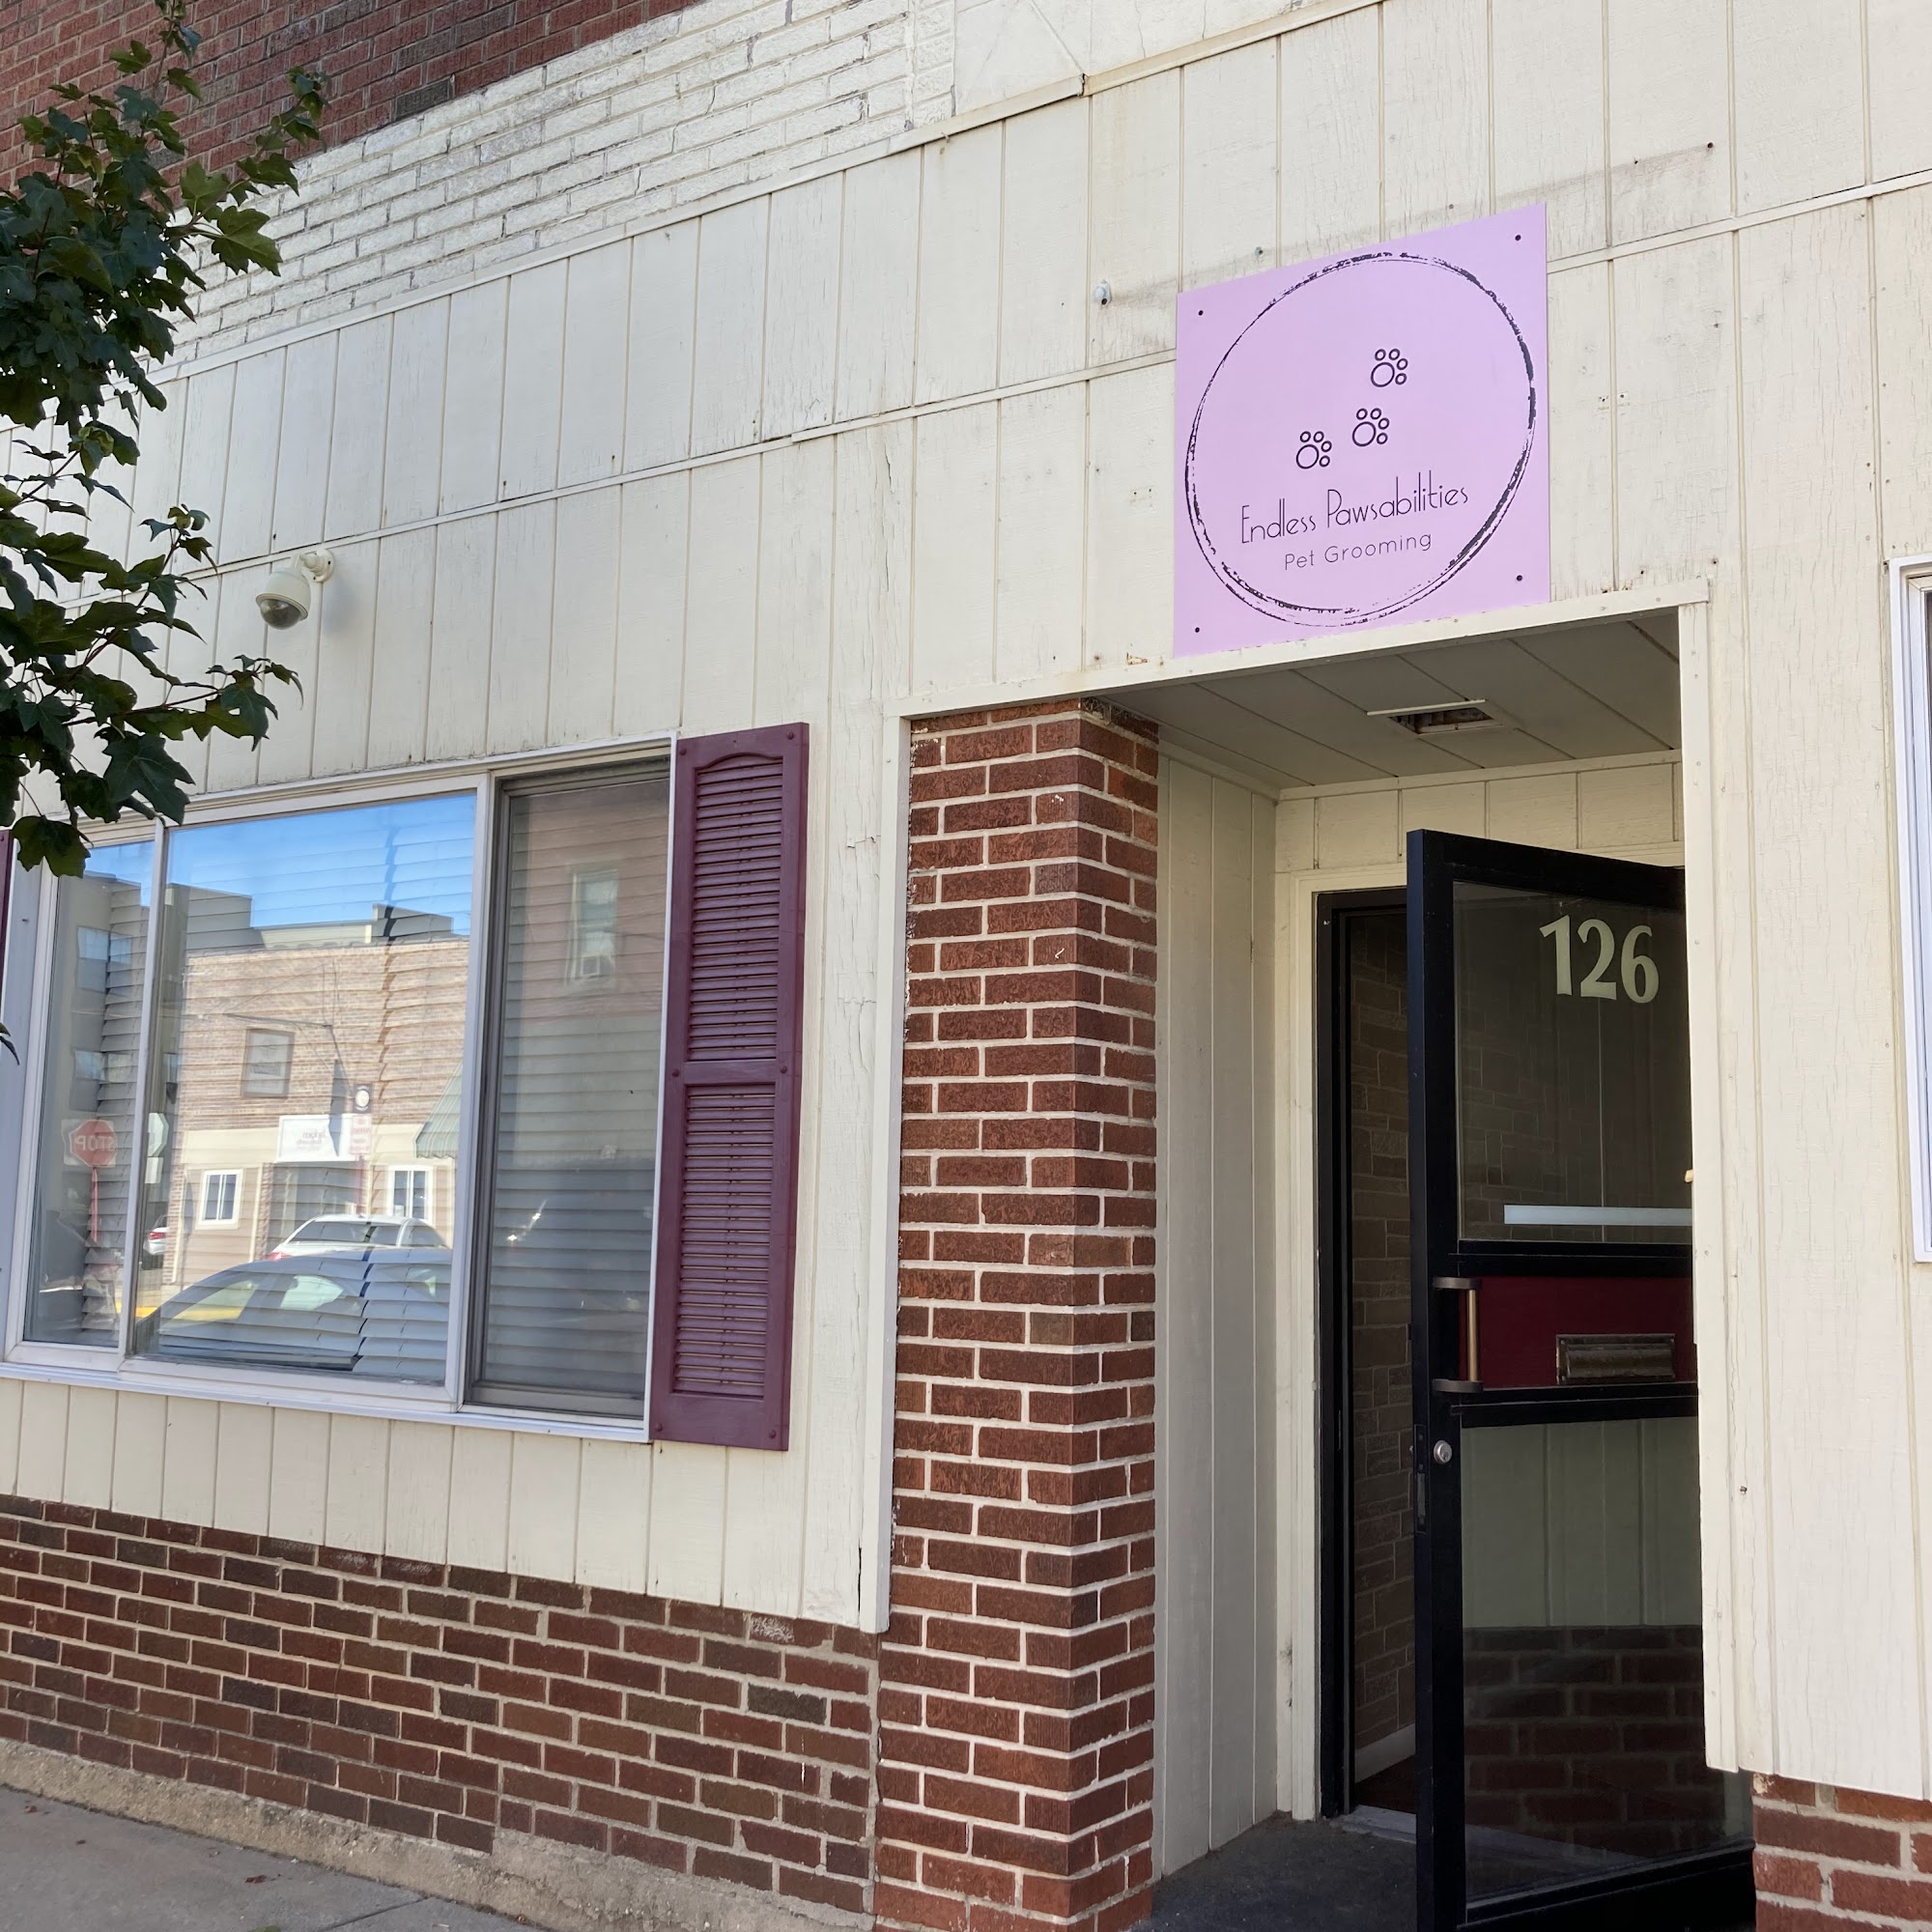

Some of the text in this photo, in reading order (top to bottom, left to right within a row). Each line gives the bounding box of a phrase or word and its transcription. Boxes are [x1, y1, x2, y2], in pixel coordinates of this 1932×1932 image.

[1241, 469, 1468, 544] Endless Pawsabilities
[1285, 533, 1432, 571] Pet Grooming
[1539, 914, 1660, 1004] 126
